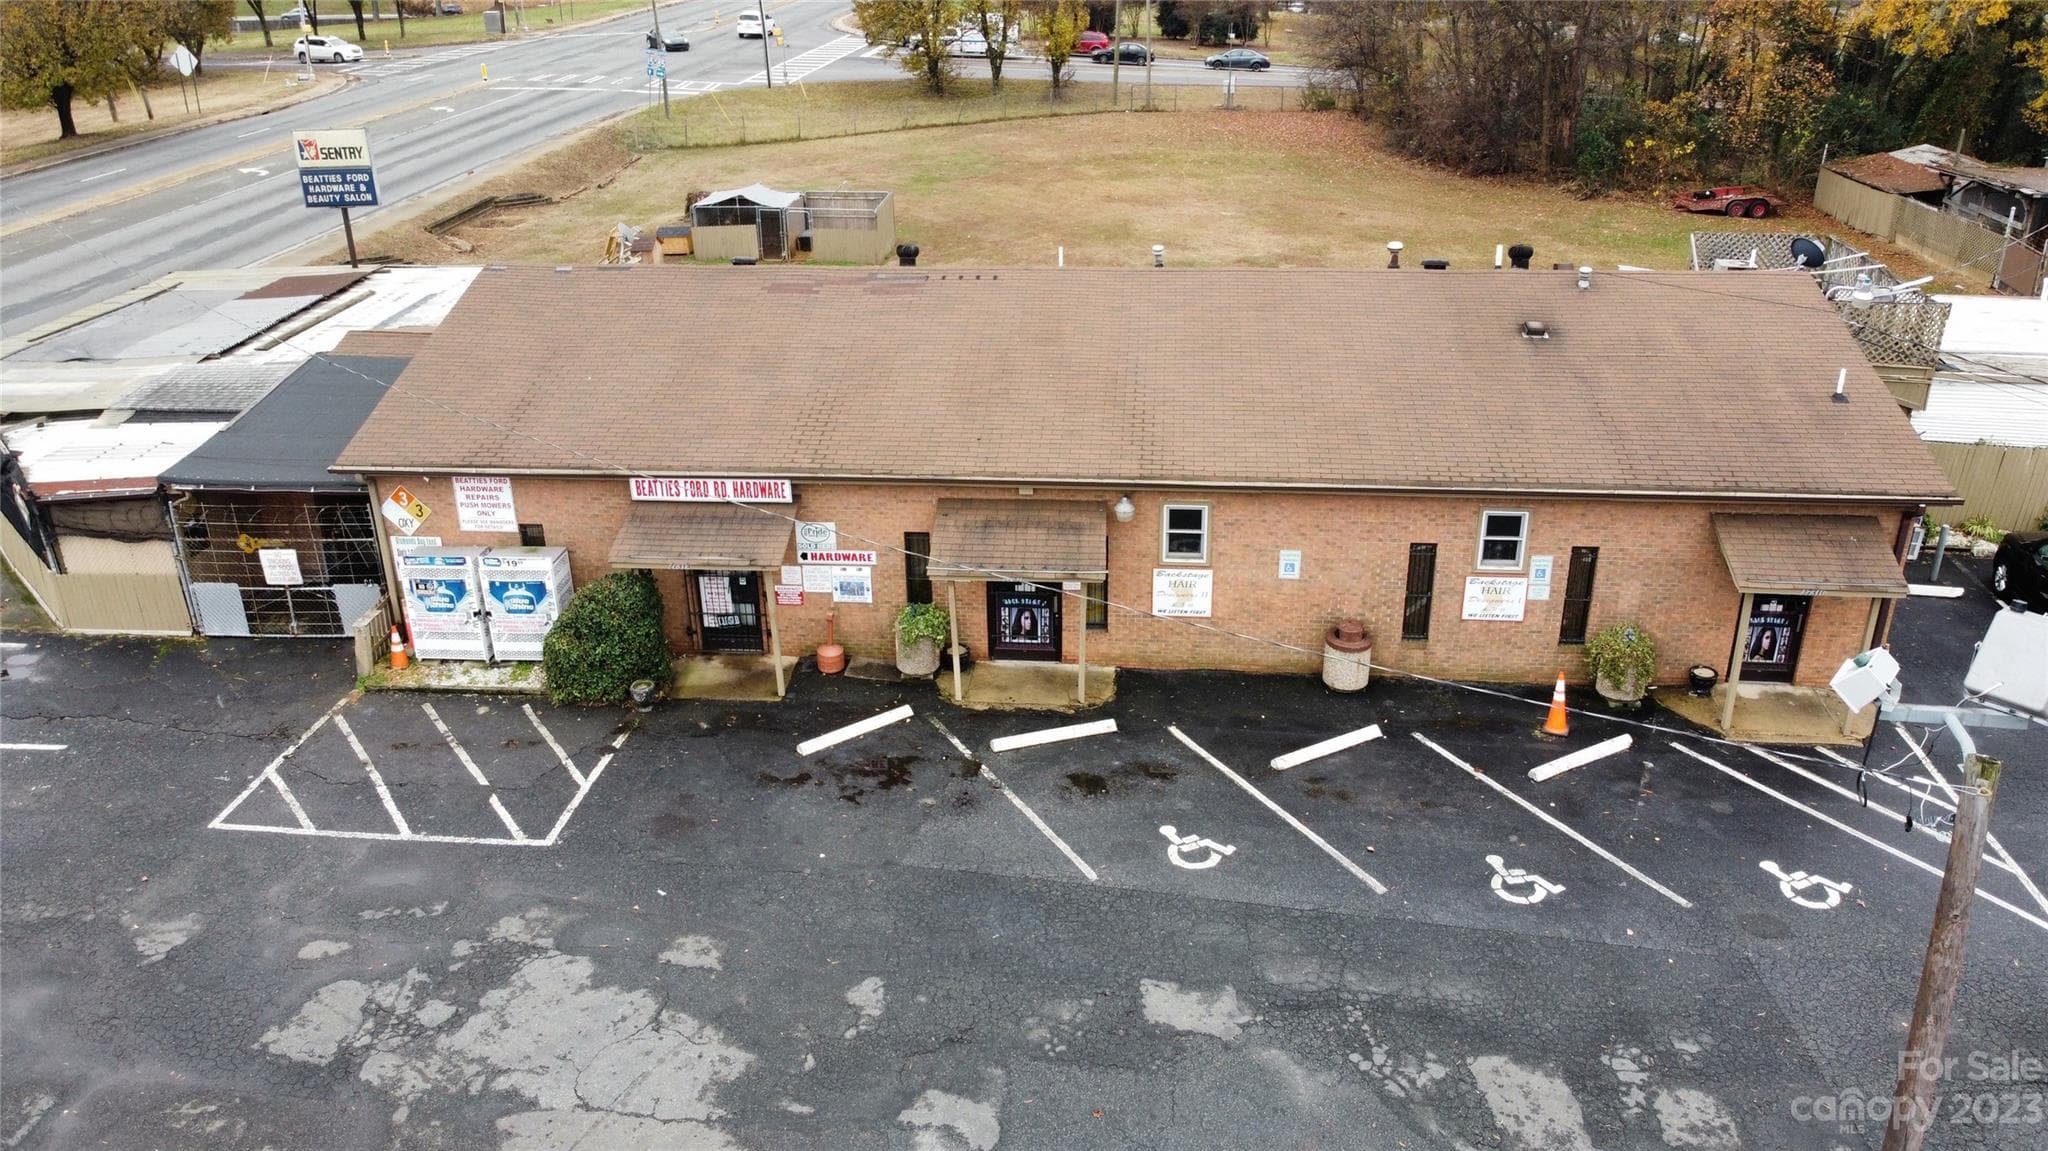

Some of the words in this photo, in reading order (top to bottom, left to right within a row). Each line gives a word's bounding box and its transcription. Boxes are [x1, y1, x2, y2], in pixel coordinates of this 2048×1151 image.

[320, 146, 363, 160] SENTRY
[302, 174, 342, 183] BEATTIES
[346, 173, 369, 182] FORD
[309, 183, 356, 193] HARDWARE
[360, 183, 367, 192] &
[307, 195, 340, 203] BEAUTY
[344, 193, 372, 202] SALON
[635, 479, 681, 497] BEATTIES
[684, 480, 709, 498] FORD
[714, 481, 731, 499] RD.
[733, 481, 787, 499] HARDWARE
[398, 491, 408, 506] 3
[416, 504, 424, 518] 3
[398, 518, 414, 528] OXY
[810, 552, 874, 562] HARDWARE
[1168, 579, 1198, 588] HAIR
[1481, 586, 1511, 595] HAIR
